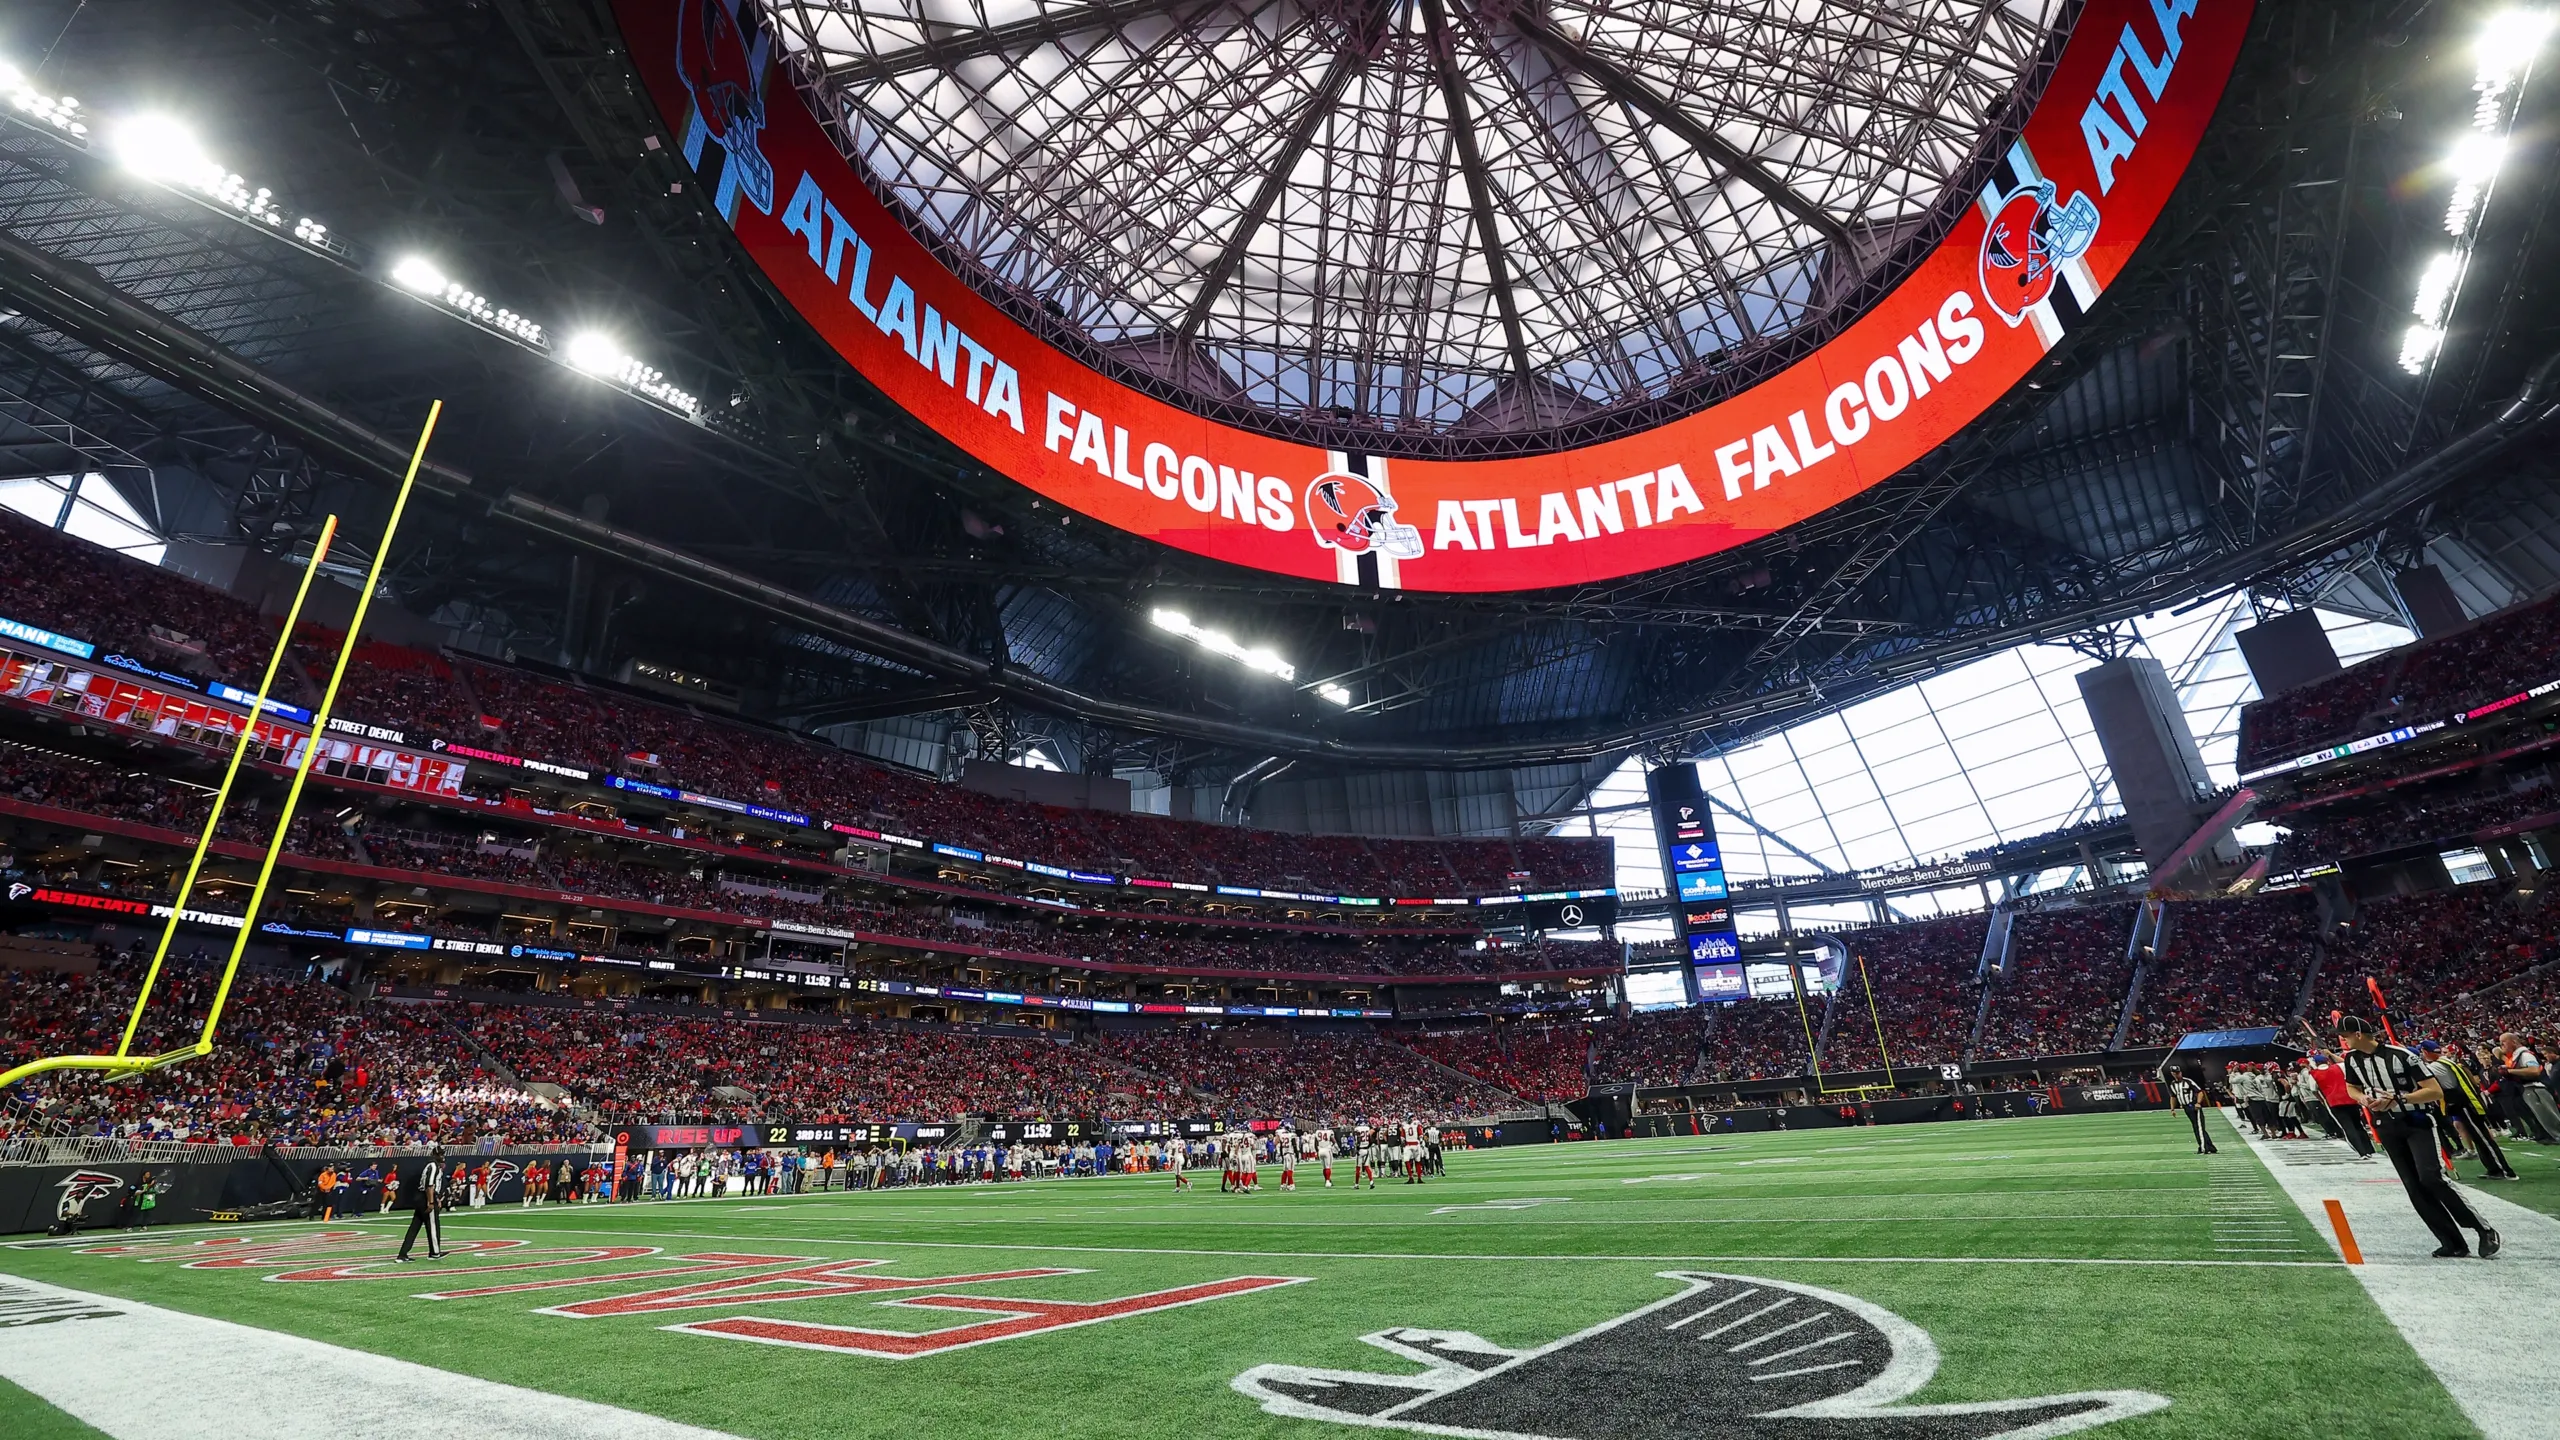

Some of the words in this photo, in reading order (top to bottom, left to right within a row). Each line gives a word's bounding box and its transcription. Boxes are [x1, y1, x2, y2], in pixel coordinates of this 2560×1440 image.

[781, 170, 1025, 434] ATLANTA
[1044, 390, 1295, 532] FALCONS
[1433, 463, 1704, 551] ATLANTA
[1714, 290, 1985, 501] FALCONS
[56, 636, 84, 650] Staffing
[2467, 692, 2529, 719] ASSOCIATE
[329, 717, 368, 735] STREET
[367, 726, 404, 743] DENTAL
[2317, 752, 2333, 761] NYJ
[2376, 735, 2389, 745] LA
[446, 743, 523, 767] ASSOCIATE
[523, 758, 589, 780] PARTNERS
[649, 784, 672, 795] Security
[751, 807, 774, 818] taylor
[778, 812, 804, 824] english
[832, 824, 880, 840] ASSOCIATE
[1860, 869, 1942, 891] Mercedes-Benz
[1942, 860, 1992, 877] Stadium
[1133, 879, 1171, 888] ASSOCIATE
[1683, 885, 1723, 894] COMPASS
[32, 888, 149, 915] ASSOCIATE
[1302, 894, 1324, 902] EMERY
[1687, 908, 1728, 925] Peachtree
[772, 920, 825, 935] Mercedes-Benz
[826, 927, 855, 939] Stadium
[446, 940, 476, 952] STREET
[475, 943, 504, 955] DENTAL
[525, 947, 549, 956] Reliable
[549, 950, 575, 959] Security
[1693, 946, 1736, 958] EMERY
[649, 960, 675, 970] GIANTS
[721, 966, 728, 977] 7
[787, 975, 796, 983] 22
[804, 974, 831, 987] 11:52
[858, 980, 869, 990] 22
[879, 982, 889, 992] 31
[379, 985, 392, 993] 125
[1143, 1004, 1185, 1013] ASSOCIATE
[1942, 1066, 1960, 1079] 22
[2093, 1093, 2126, 1101] CHANGE
[991, 1129, 1006, 1140] 4TH
[1023, 1124, 1053, 1138] 11:52
[1067, 1124, 1080, 1136] 22
[1150, 1123, 1160, 1135] 31
[1214, 1121, 1224, 1132] 22
[1267, 1120, 1280, 1130] UP
[656, 1128, 710, 1145] RISE
[713, 1127, 742, 1142] UP
[769, 1127, 787, 1142] 22
[795, 1130, 814, 1141] 3RD
[815, 1130, 823, 1140] &
[823, 1130, 834, 1140] 11
[856, 1129, 867, 1141] 22
[889, 1126, 898, 1138] 7
[916, 1127, 945, 1138] GIANTS
[1317, 1130, 1328, 1142] 94
